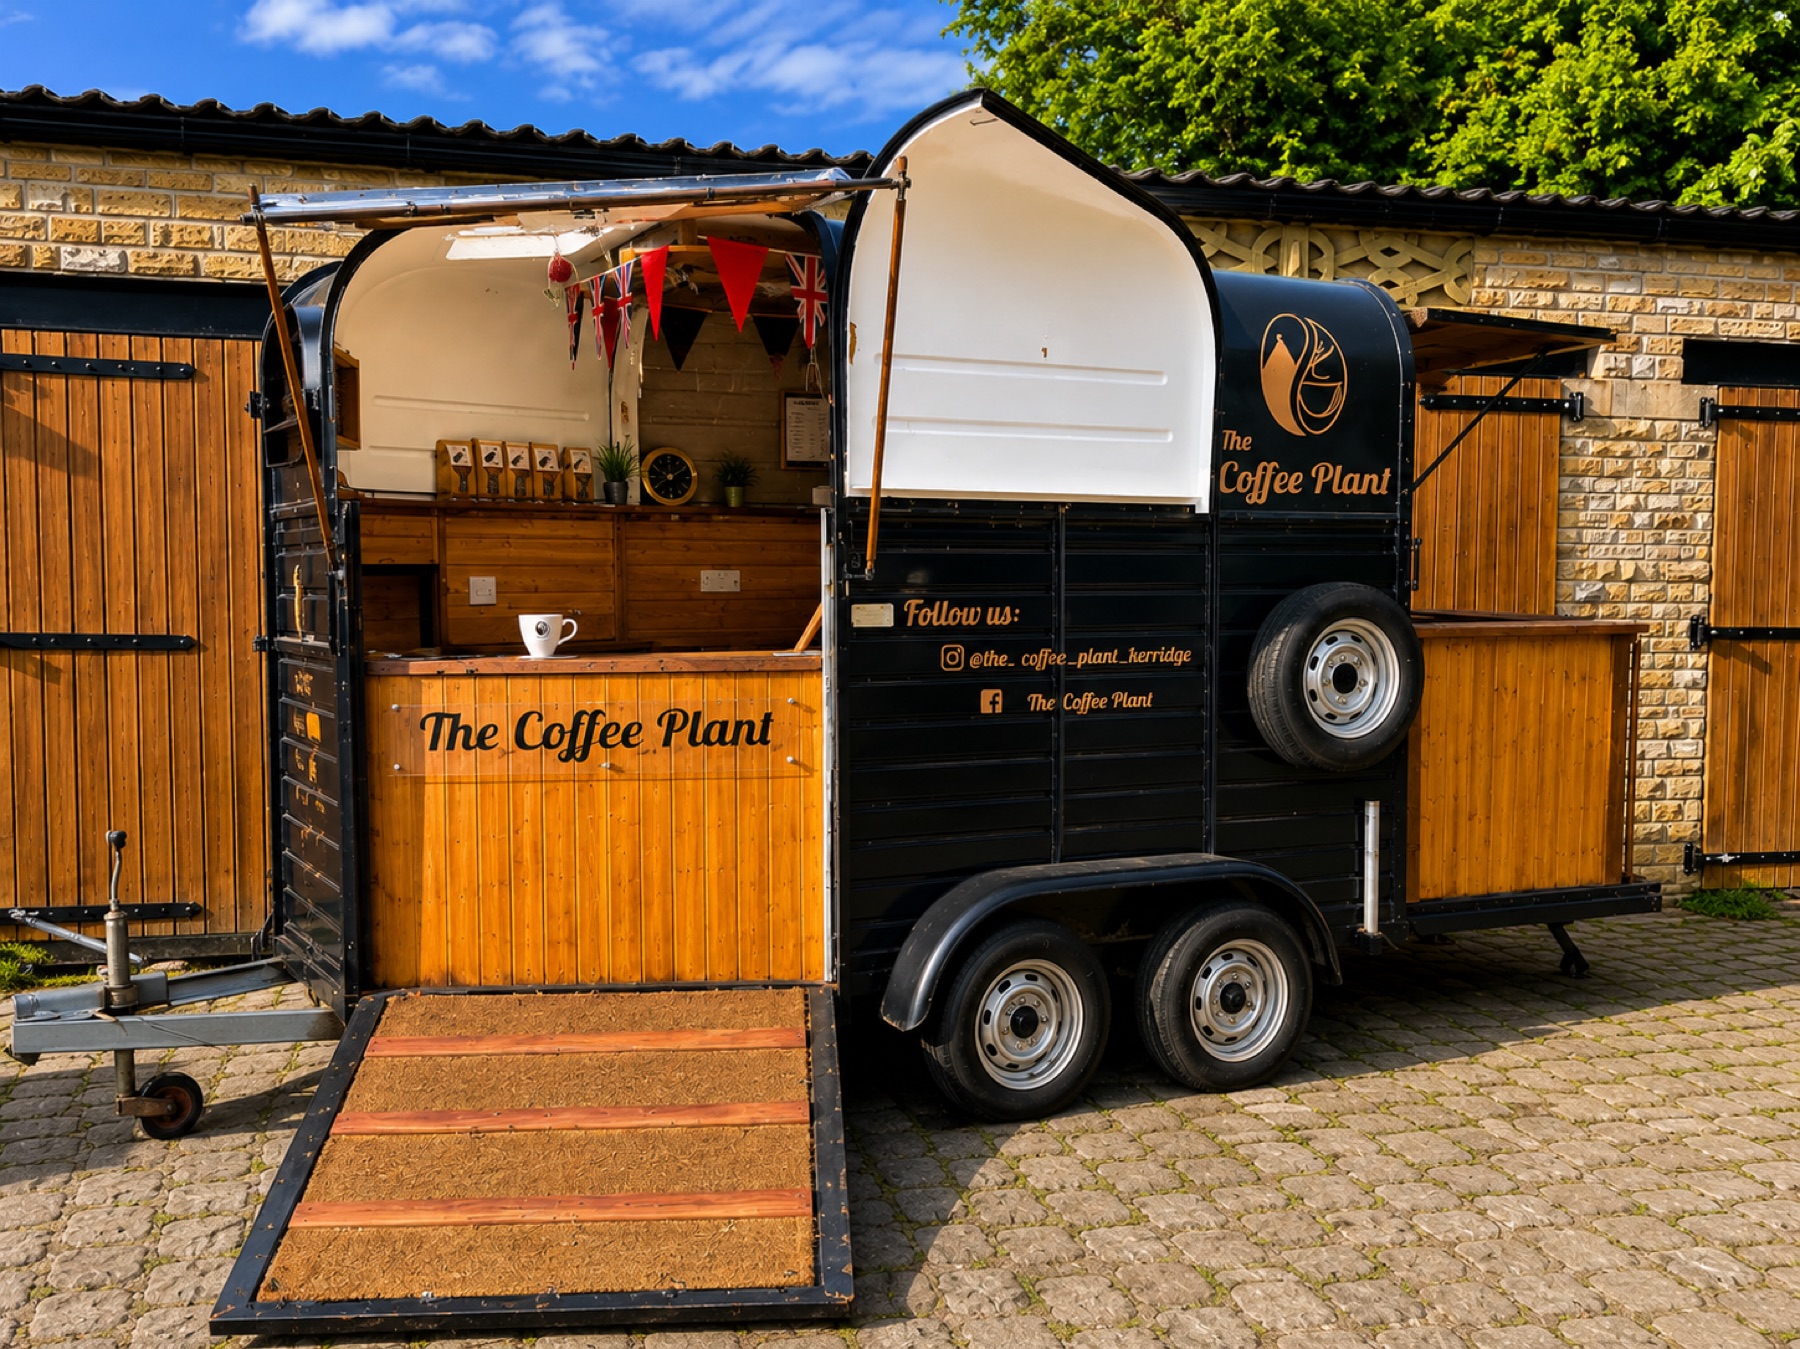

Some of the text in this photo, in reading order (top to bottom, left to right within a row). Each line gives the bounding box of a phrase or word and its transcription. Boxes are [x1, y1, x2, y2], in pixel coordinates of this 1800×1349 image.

[1222, 429, 1252, 451] The
[1219, 460, 1391, 504] Coffee Plant
[903, 599, 1020, 628] Follow us:
[1027, 693, 1056, 712] The
[1062, 692, 1108, 715] Coffee
[1111, 691, 1154, 709] Plant
[419, 708, 775, 764] The Coffee Plant
